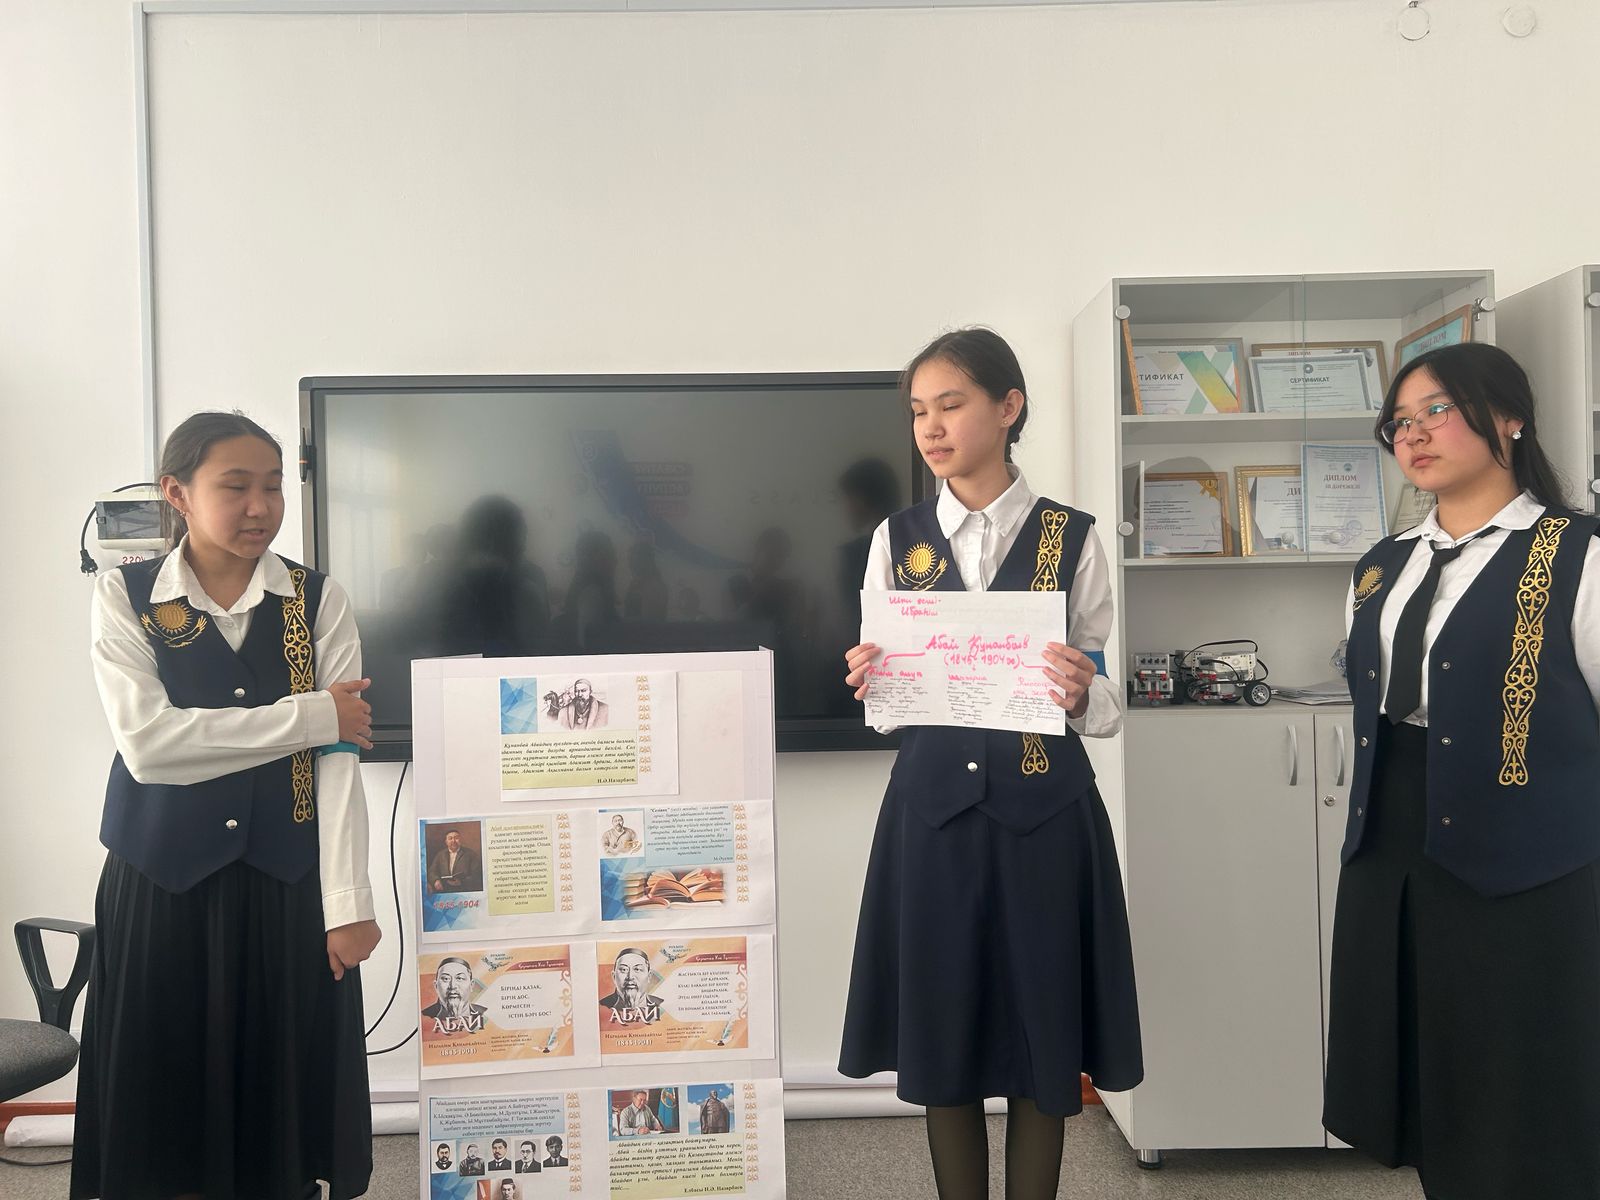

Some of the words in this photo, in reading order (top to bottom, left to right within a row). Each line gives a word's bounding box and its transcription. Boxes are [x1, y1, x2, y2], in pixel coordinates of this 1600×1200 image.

[1289, 376, 1330, 385] СЕРТИФИКАТ
[1323, 474, 1357, 482] ДИПЛОМ
[925, 634, 960, 652] Абай
[432, 1011, 484, 1034] АБАЙ
[610, 1002, 660, 1026] АБАЙ
